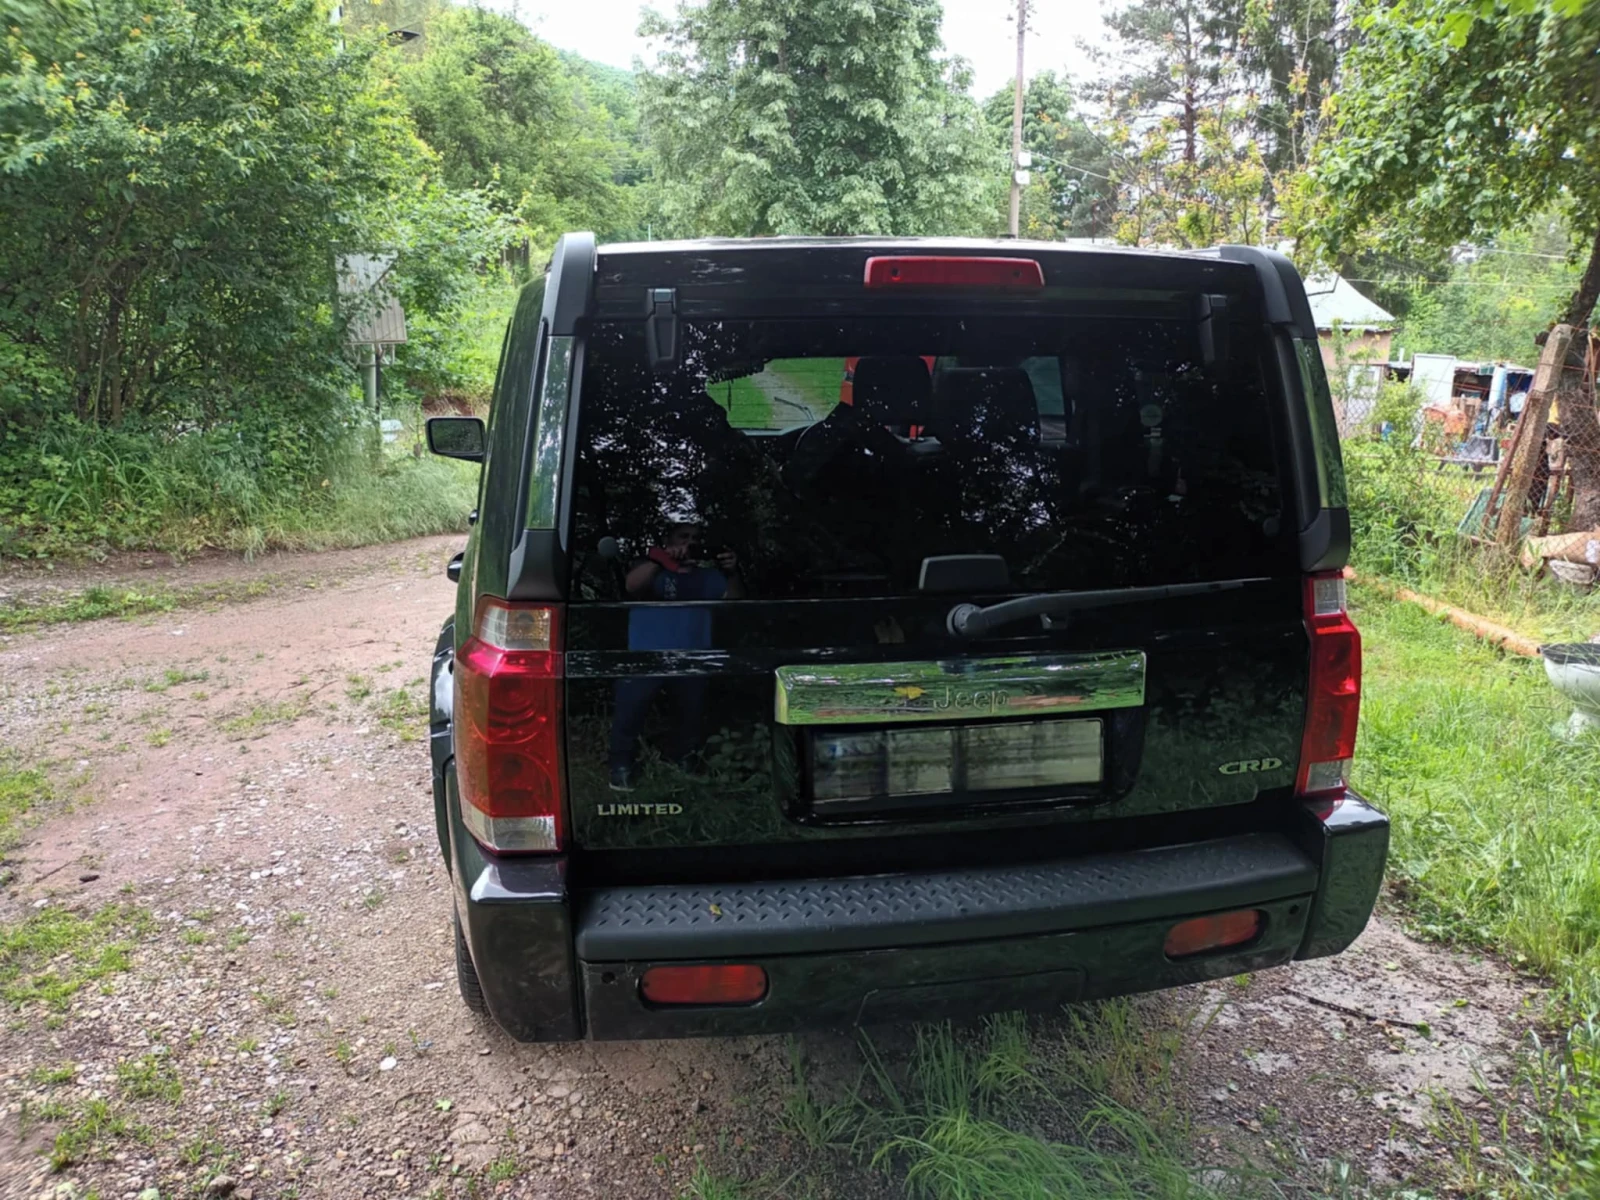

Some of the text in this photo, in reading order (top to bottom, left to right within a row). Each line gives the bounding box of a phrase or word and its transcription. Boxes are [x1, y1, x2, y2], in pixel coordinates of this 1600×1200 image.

[933, 685, 1009, 713] Jeep
[1218, 757, 1282, 775] CRD
[597, 803, 683, 816] LIMITED
